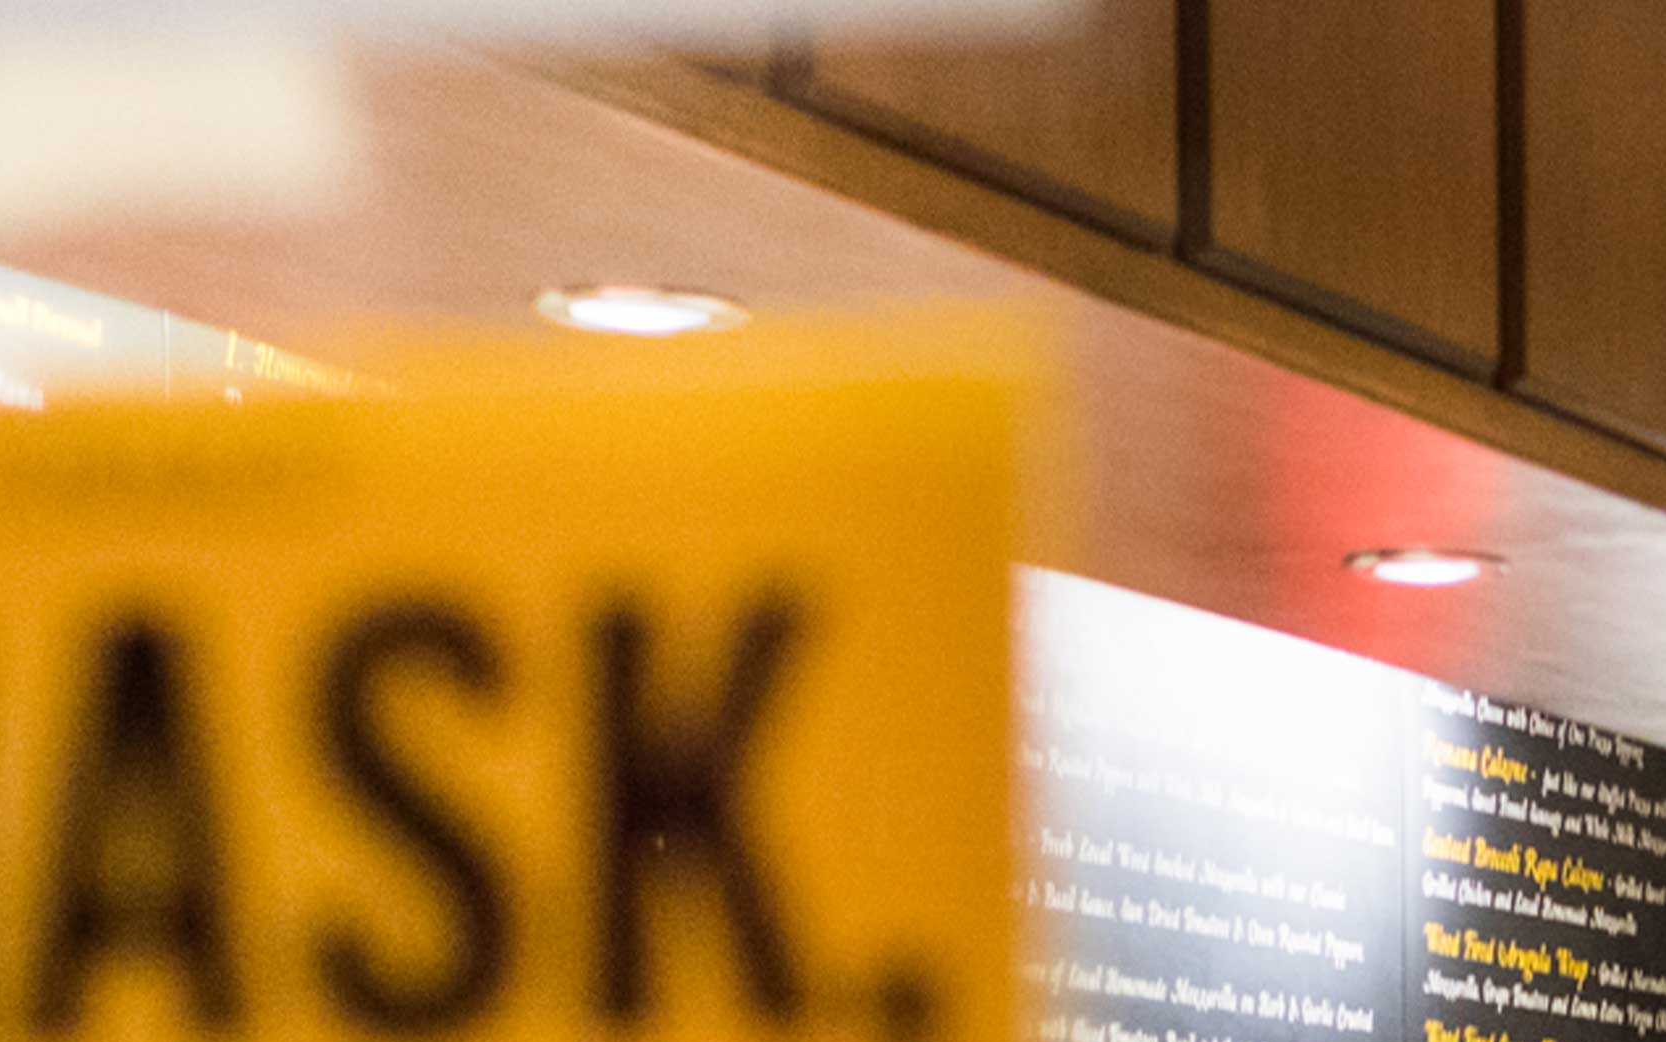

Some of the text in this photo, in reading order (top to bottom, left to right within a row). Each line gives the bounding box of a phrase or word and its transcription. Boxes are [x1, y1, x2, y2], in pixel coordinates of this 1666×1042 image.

[1424, 921, 1461, 959] Wood
[1463, 928, 1495, 965] Fired
[1169, 976, 1237, 1015] Mozzarella
